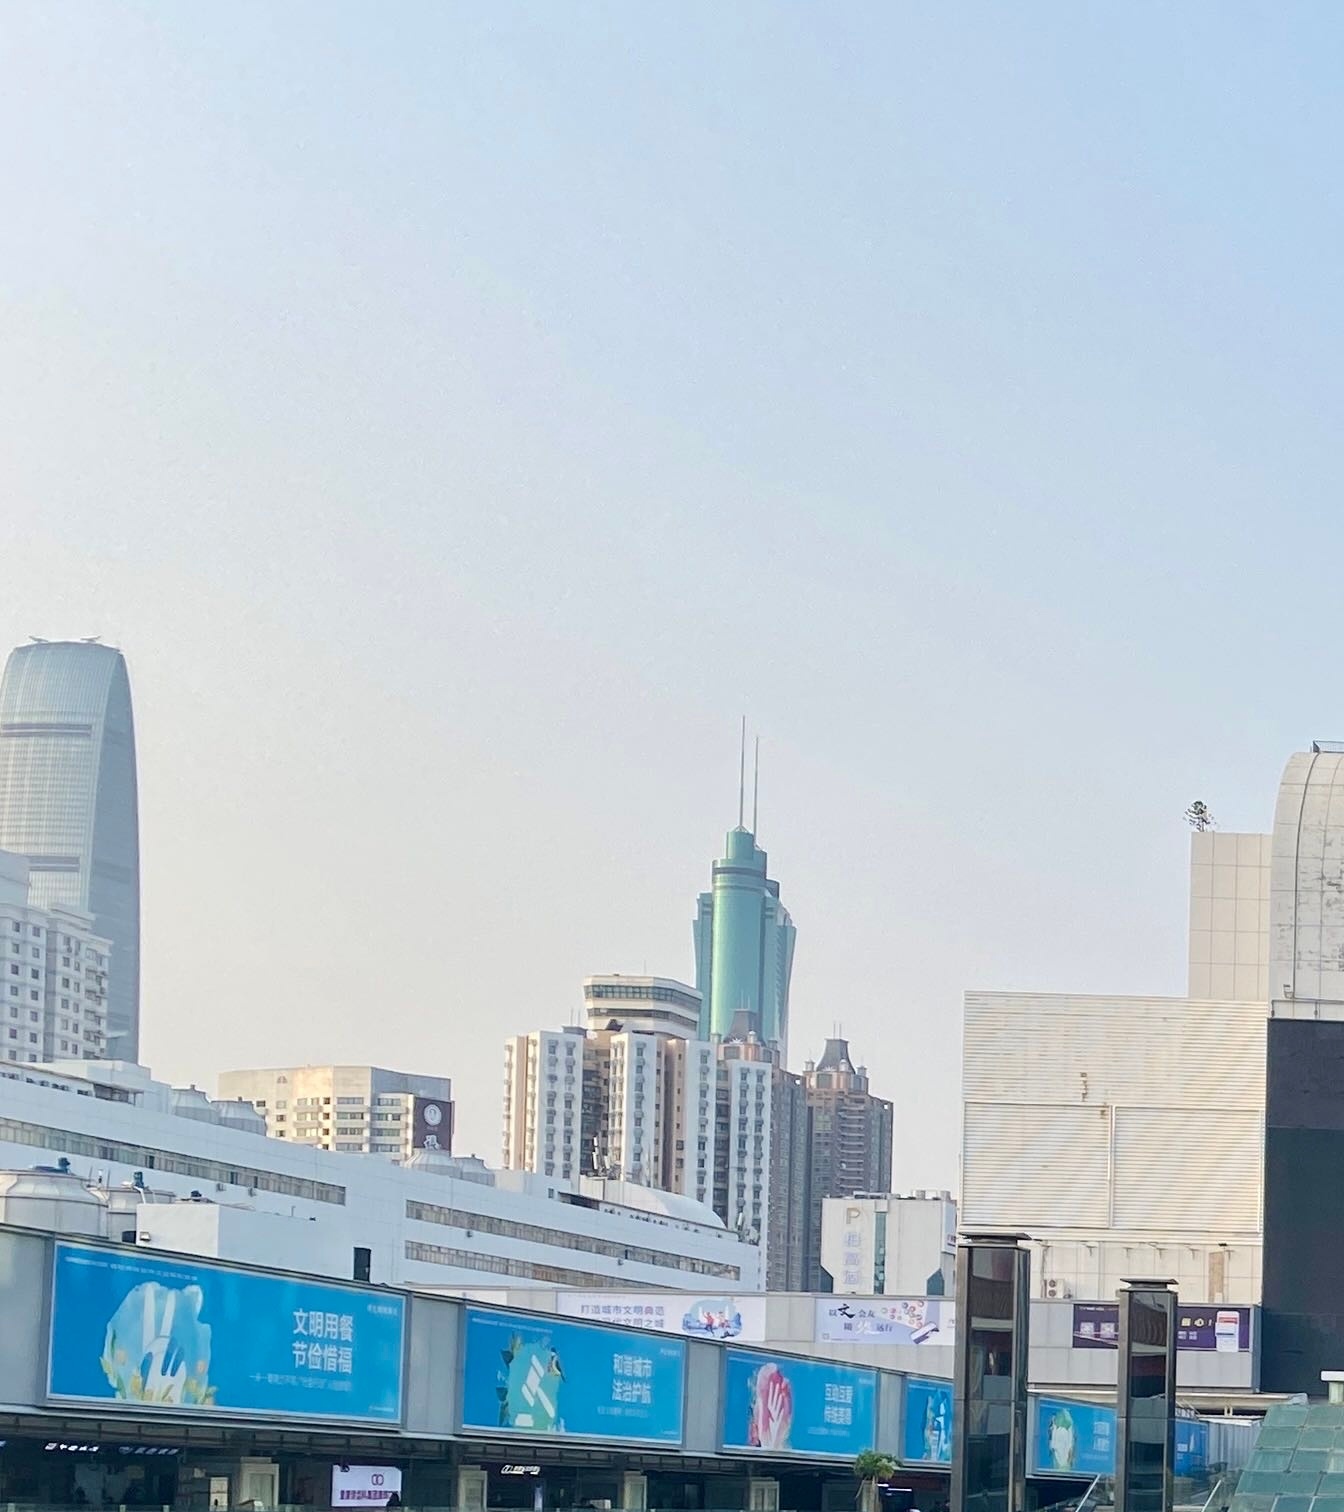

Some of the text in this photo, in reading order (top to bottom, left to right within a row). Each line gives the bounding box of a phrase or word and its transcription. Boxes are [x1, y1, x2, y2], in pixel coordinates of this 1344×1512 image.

[292, 1308, 355, 1342] 文明用餐
[291, 1341, 354, 1375] 节俭惜福
